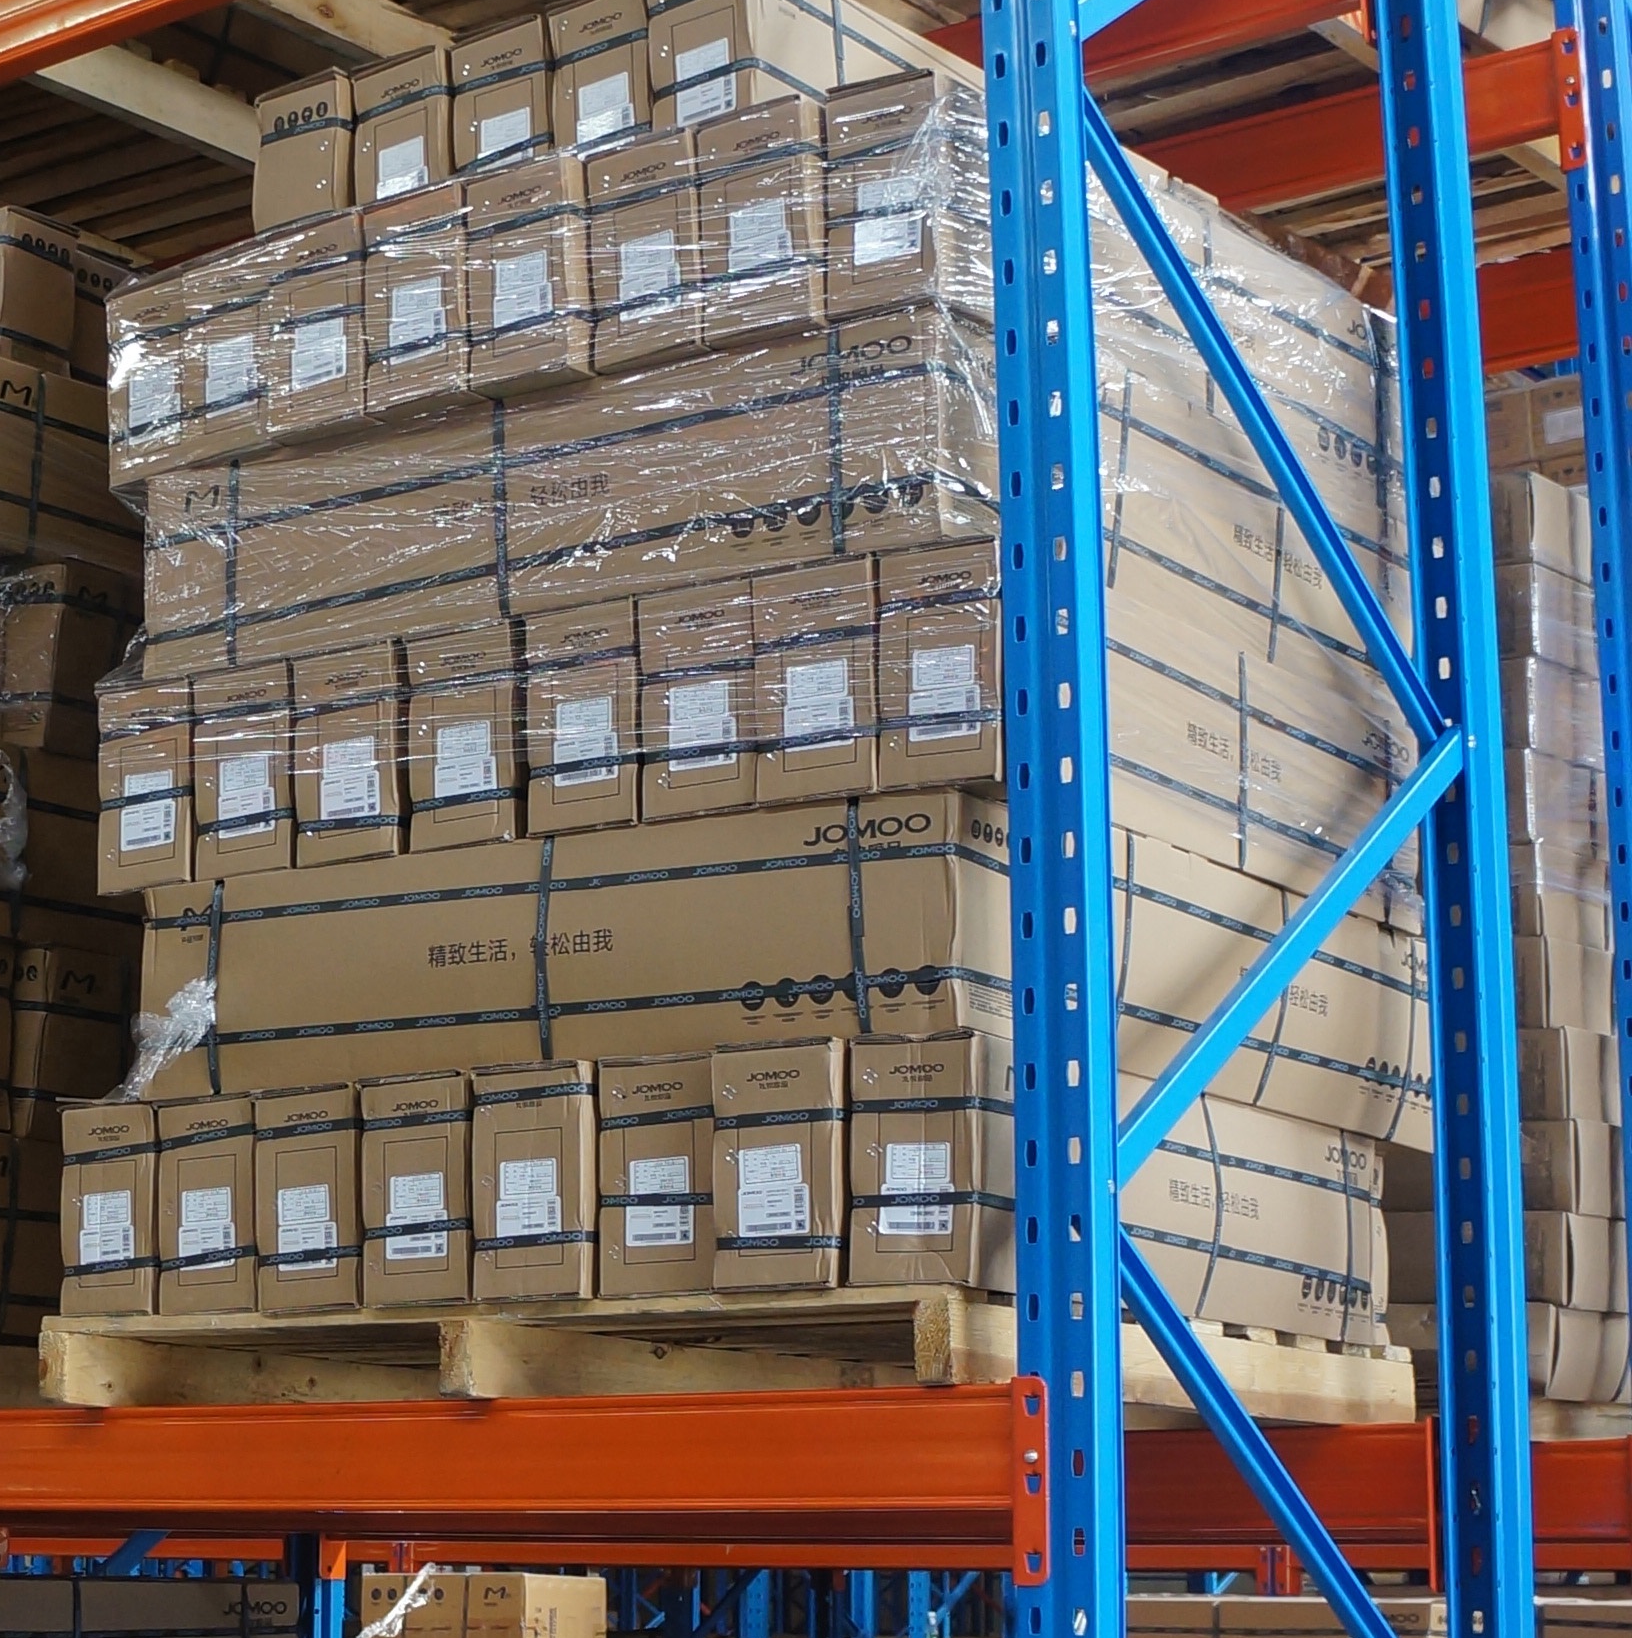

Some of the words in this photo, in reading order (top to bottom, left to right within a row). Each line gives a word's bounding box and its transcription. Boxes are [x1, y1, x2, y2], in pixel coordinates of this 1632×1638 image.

[804, 813, 931, 847] JOMOO
[889, 1064, 944, 1075] JOMOO
[746, 1070, 800, 1083] JOMOO
[632, 1082, 683, 1094] JOMOO
[392, 1100, 439, 1112] JOMOO
[284, 1111, 328, 1122] JOMOO
[88, 1125, 130, 1136] JOMOO
[186, 1119, 228, 1131] JOMOO
[1325, 1145, 1366, 1170] JOOO
